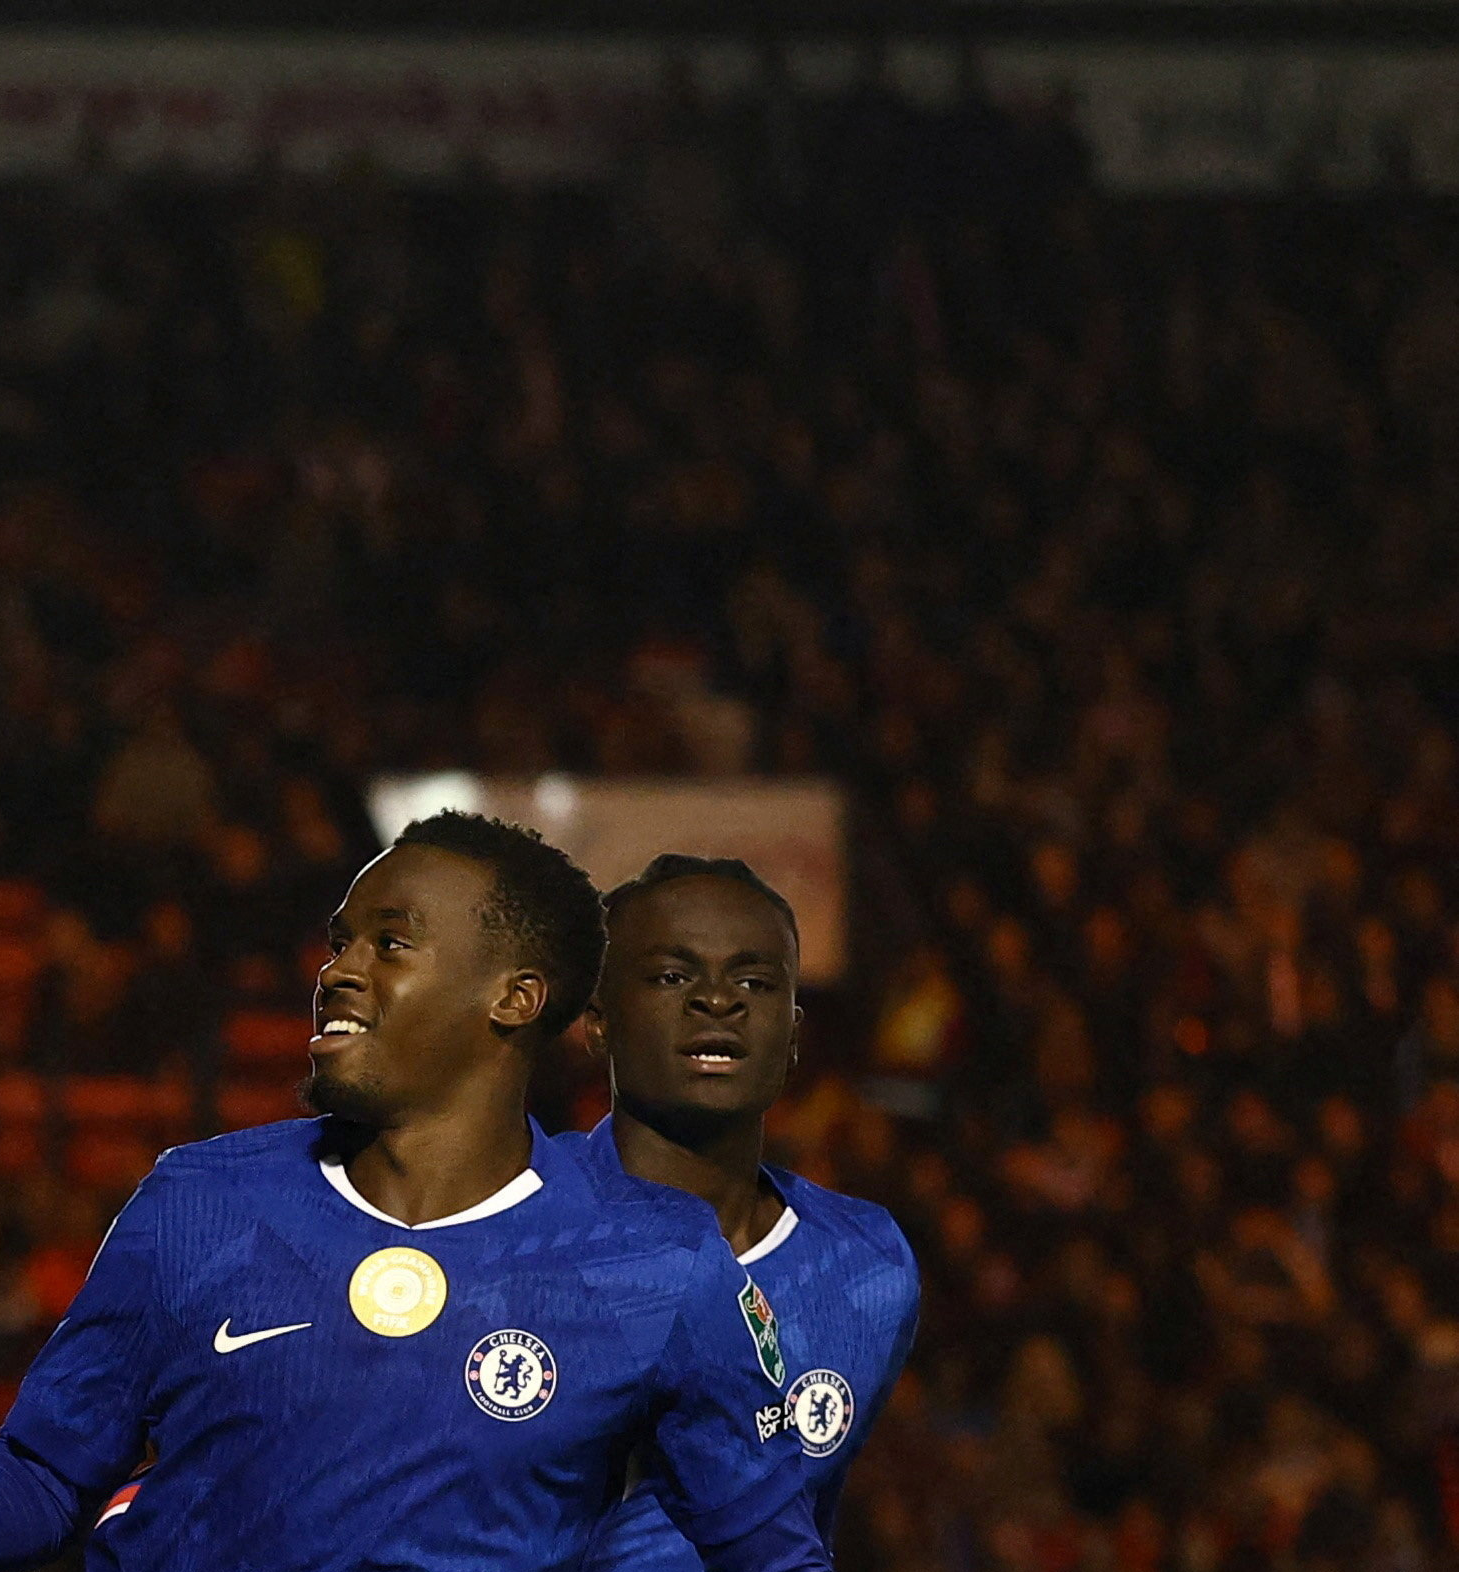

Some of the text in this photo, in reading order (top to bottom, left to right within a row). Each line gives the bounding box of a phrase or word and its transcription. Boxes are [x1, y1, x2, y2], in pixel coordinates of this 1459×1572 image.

[489, 1333, 546, 1360] CHELSEA
[801, 1372, 846, 1397] CHELSEA
[475, 1391, 534, 1416] FOOTBALL CLUB
[756, 1406, 781, 1424] No
